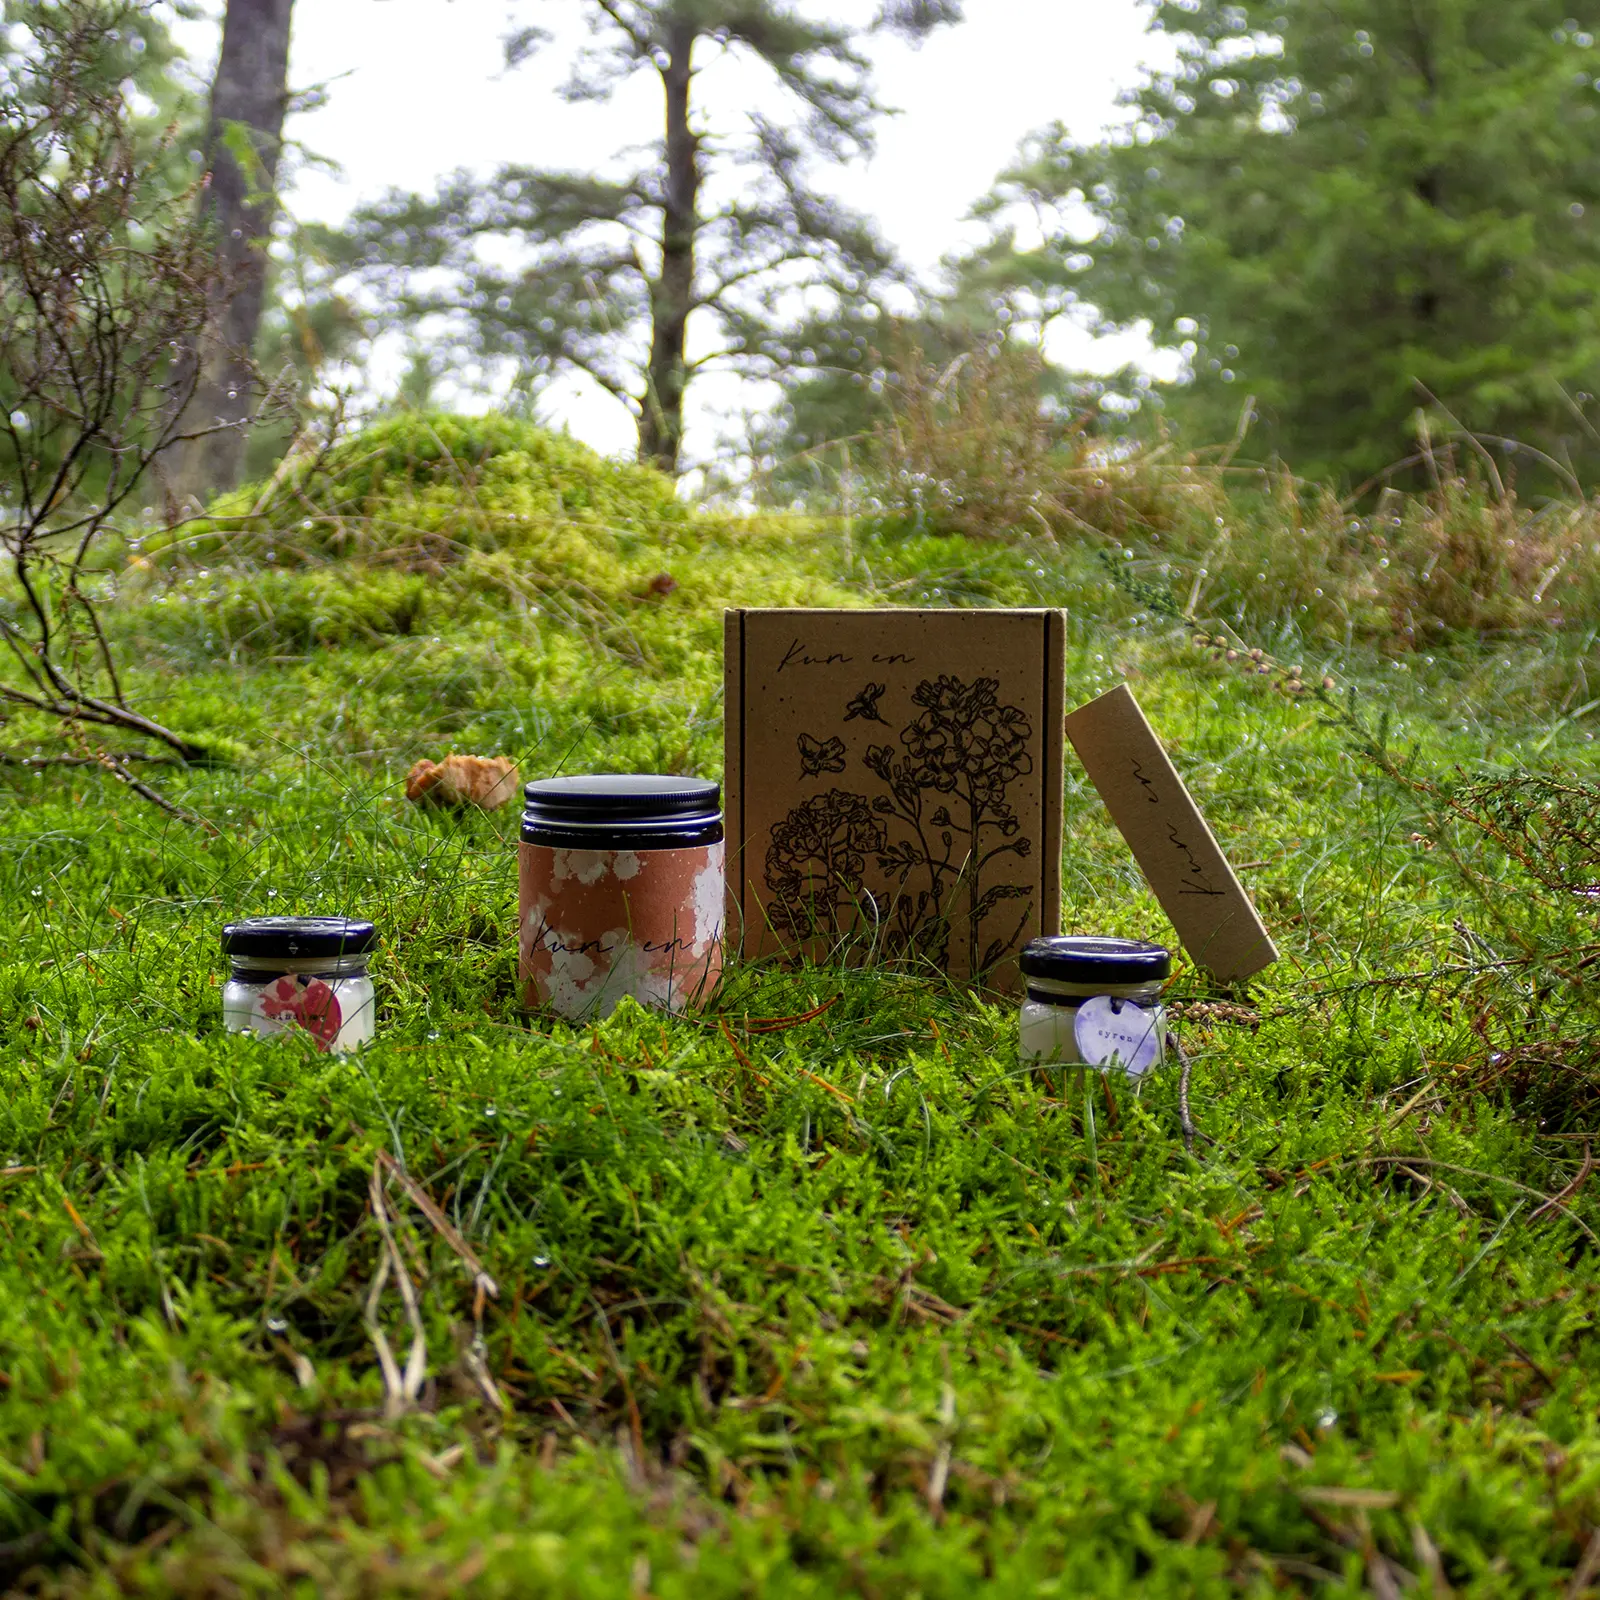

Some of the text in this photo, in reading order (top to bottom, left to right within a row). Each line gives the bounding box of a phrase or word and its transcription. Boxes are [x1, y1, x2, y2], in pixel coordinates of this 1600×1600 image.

[777, 638, 916, 672] Kun en
[1130, 758, 1226, 895] Kun en
[530, 914, 693, 958] Kun en
